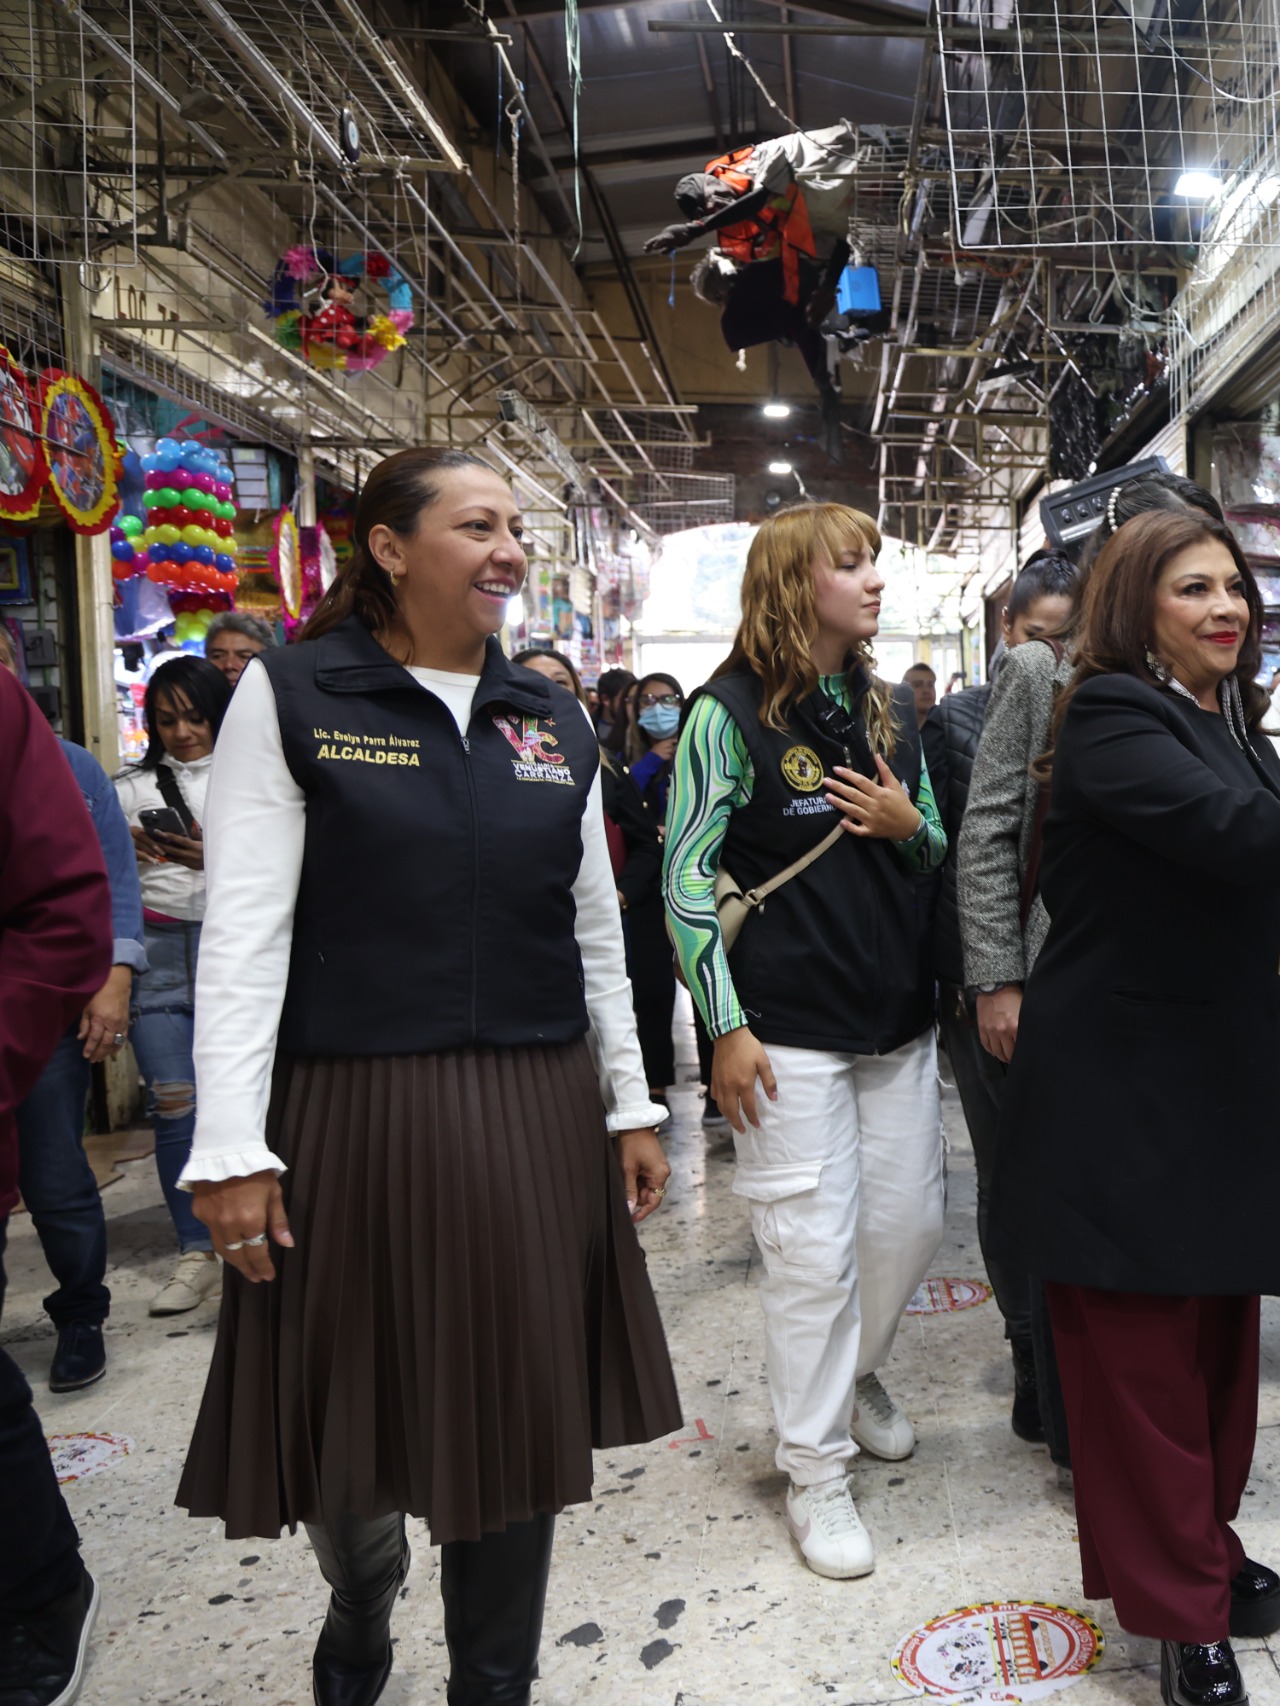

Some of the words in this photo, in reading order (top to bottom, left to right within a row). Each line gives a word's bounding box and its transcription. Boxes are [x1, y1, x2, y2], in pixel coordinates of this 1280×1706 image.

[158, 303, 179, 352] 77
[313, 727, 331, 739] Lic.
[333, 730, 360, 745] Evelyn
[363, 735, 386, 746] Parra
[389, 733, 420, 748] Álvarez
[317, 743, 420, 767] ALCALDESA
[512, 762, 571, 777] VENUSTIANO
[514, 769, 574, 783] CARRANZA
[783, 807, 795, 816] DE
